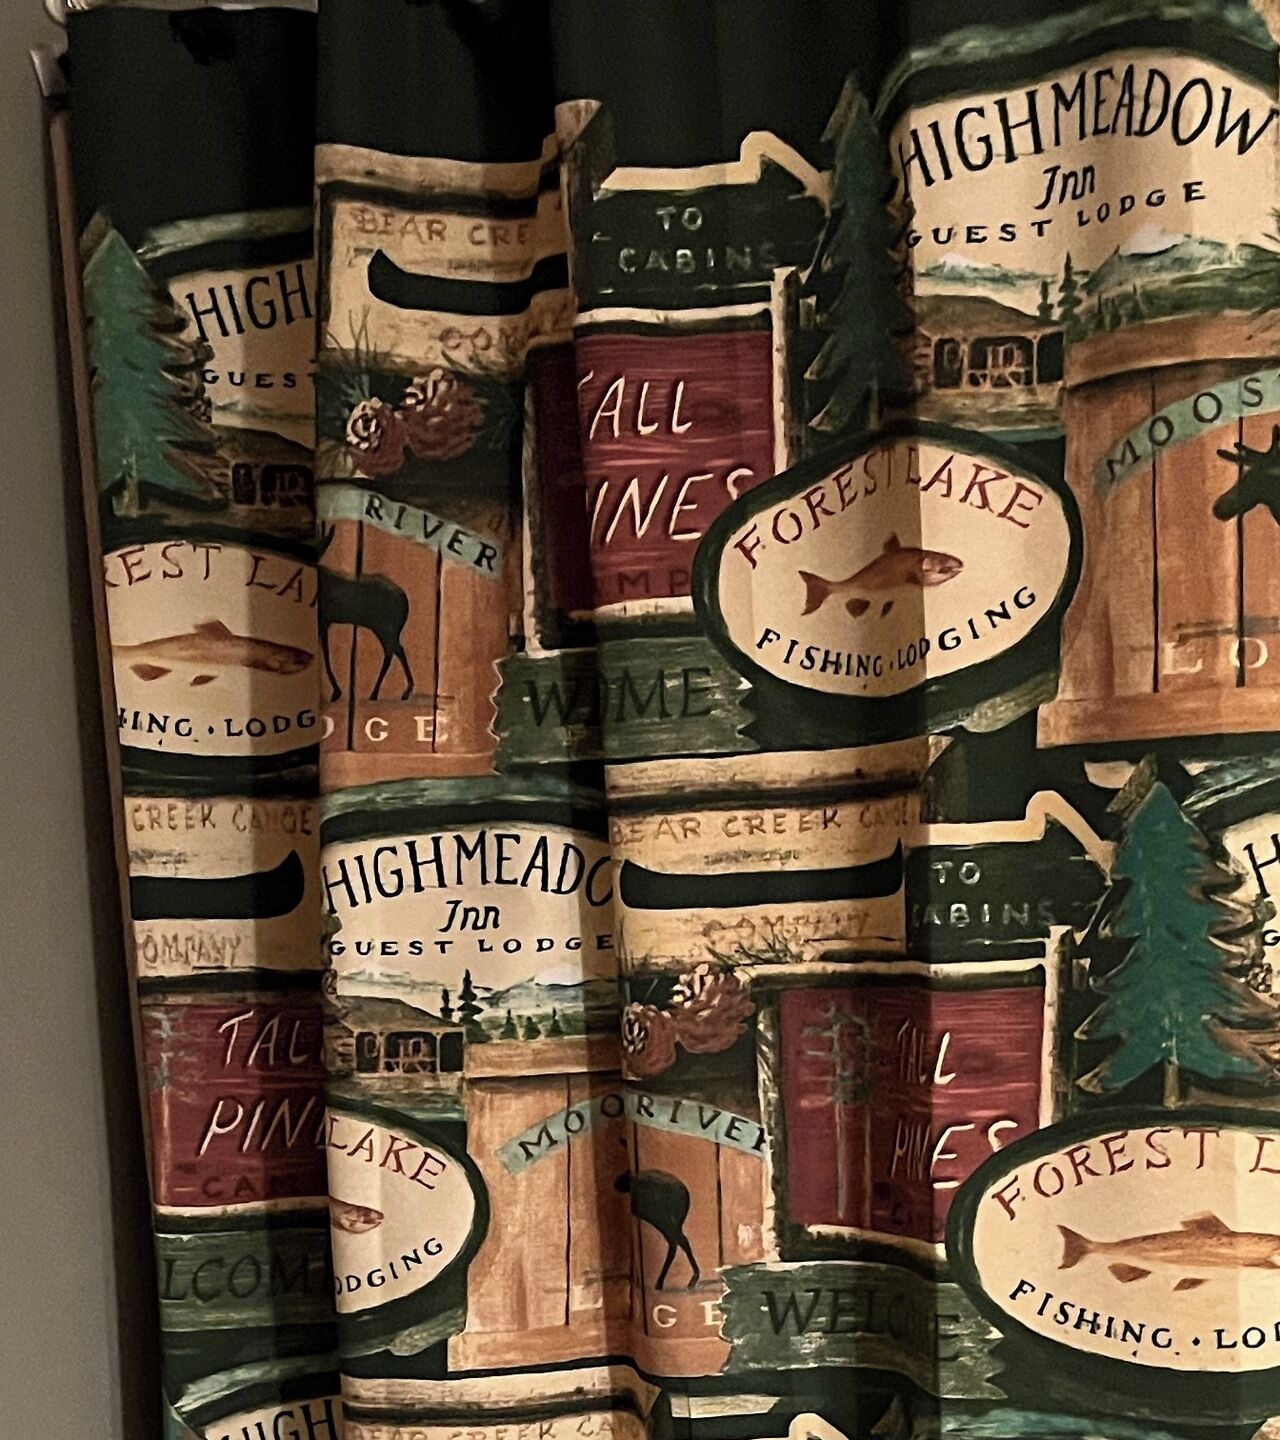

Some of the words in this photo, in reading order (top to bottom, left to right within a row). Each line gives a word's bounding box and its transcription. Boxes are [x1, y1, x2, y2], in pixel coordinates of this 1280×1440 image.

[898, 62, 1280, 201] HIGHMEADOW
[655, 206, 705, 232] TO
[905, 219, 1054, 249] GUEST
[1076, 179, 1209, 228] LODGE
[1034, 163, 1097, 210] Inn
[347, 204, 449, 244] BEAR
[185, 263, 316, 342] HIGH
[363, 493, 499, 575] RIVER
[733, 447, 898, 571] FOREST
[904, 447, 1044, 530] LAKE
[755, 627, 885, 679] FISHING
[896, 585, 1038, 672] LODGING
[225, 709, 317, 738] LODG
[720, 807, 843, 838] CREEK
[930, 860, 981, 885] TO
[327, 938, 455, 958] GUEST
[477, 934, 615, 954] LODGE
[438, 899, 501, 933] Inn
[325, 1114, 447, 1190] LAKE
[990, 1126, 1222, 1222] FOREST
[1008, 1278, 1174, 1351] FISHING
